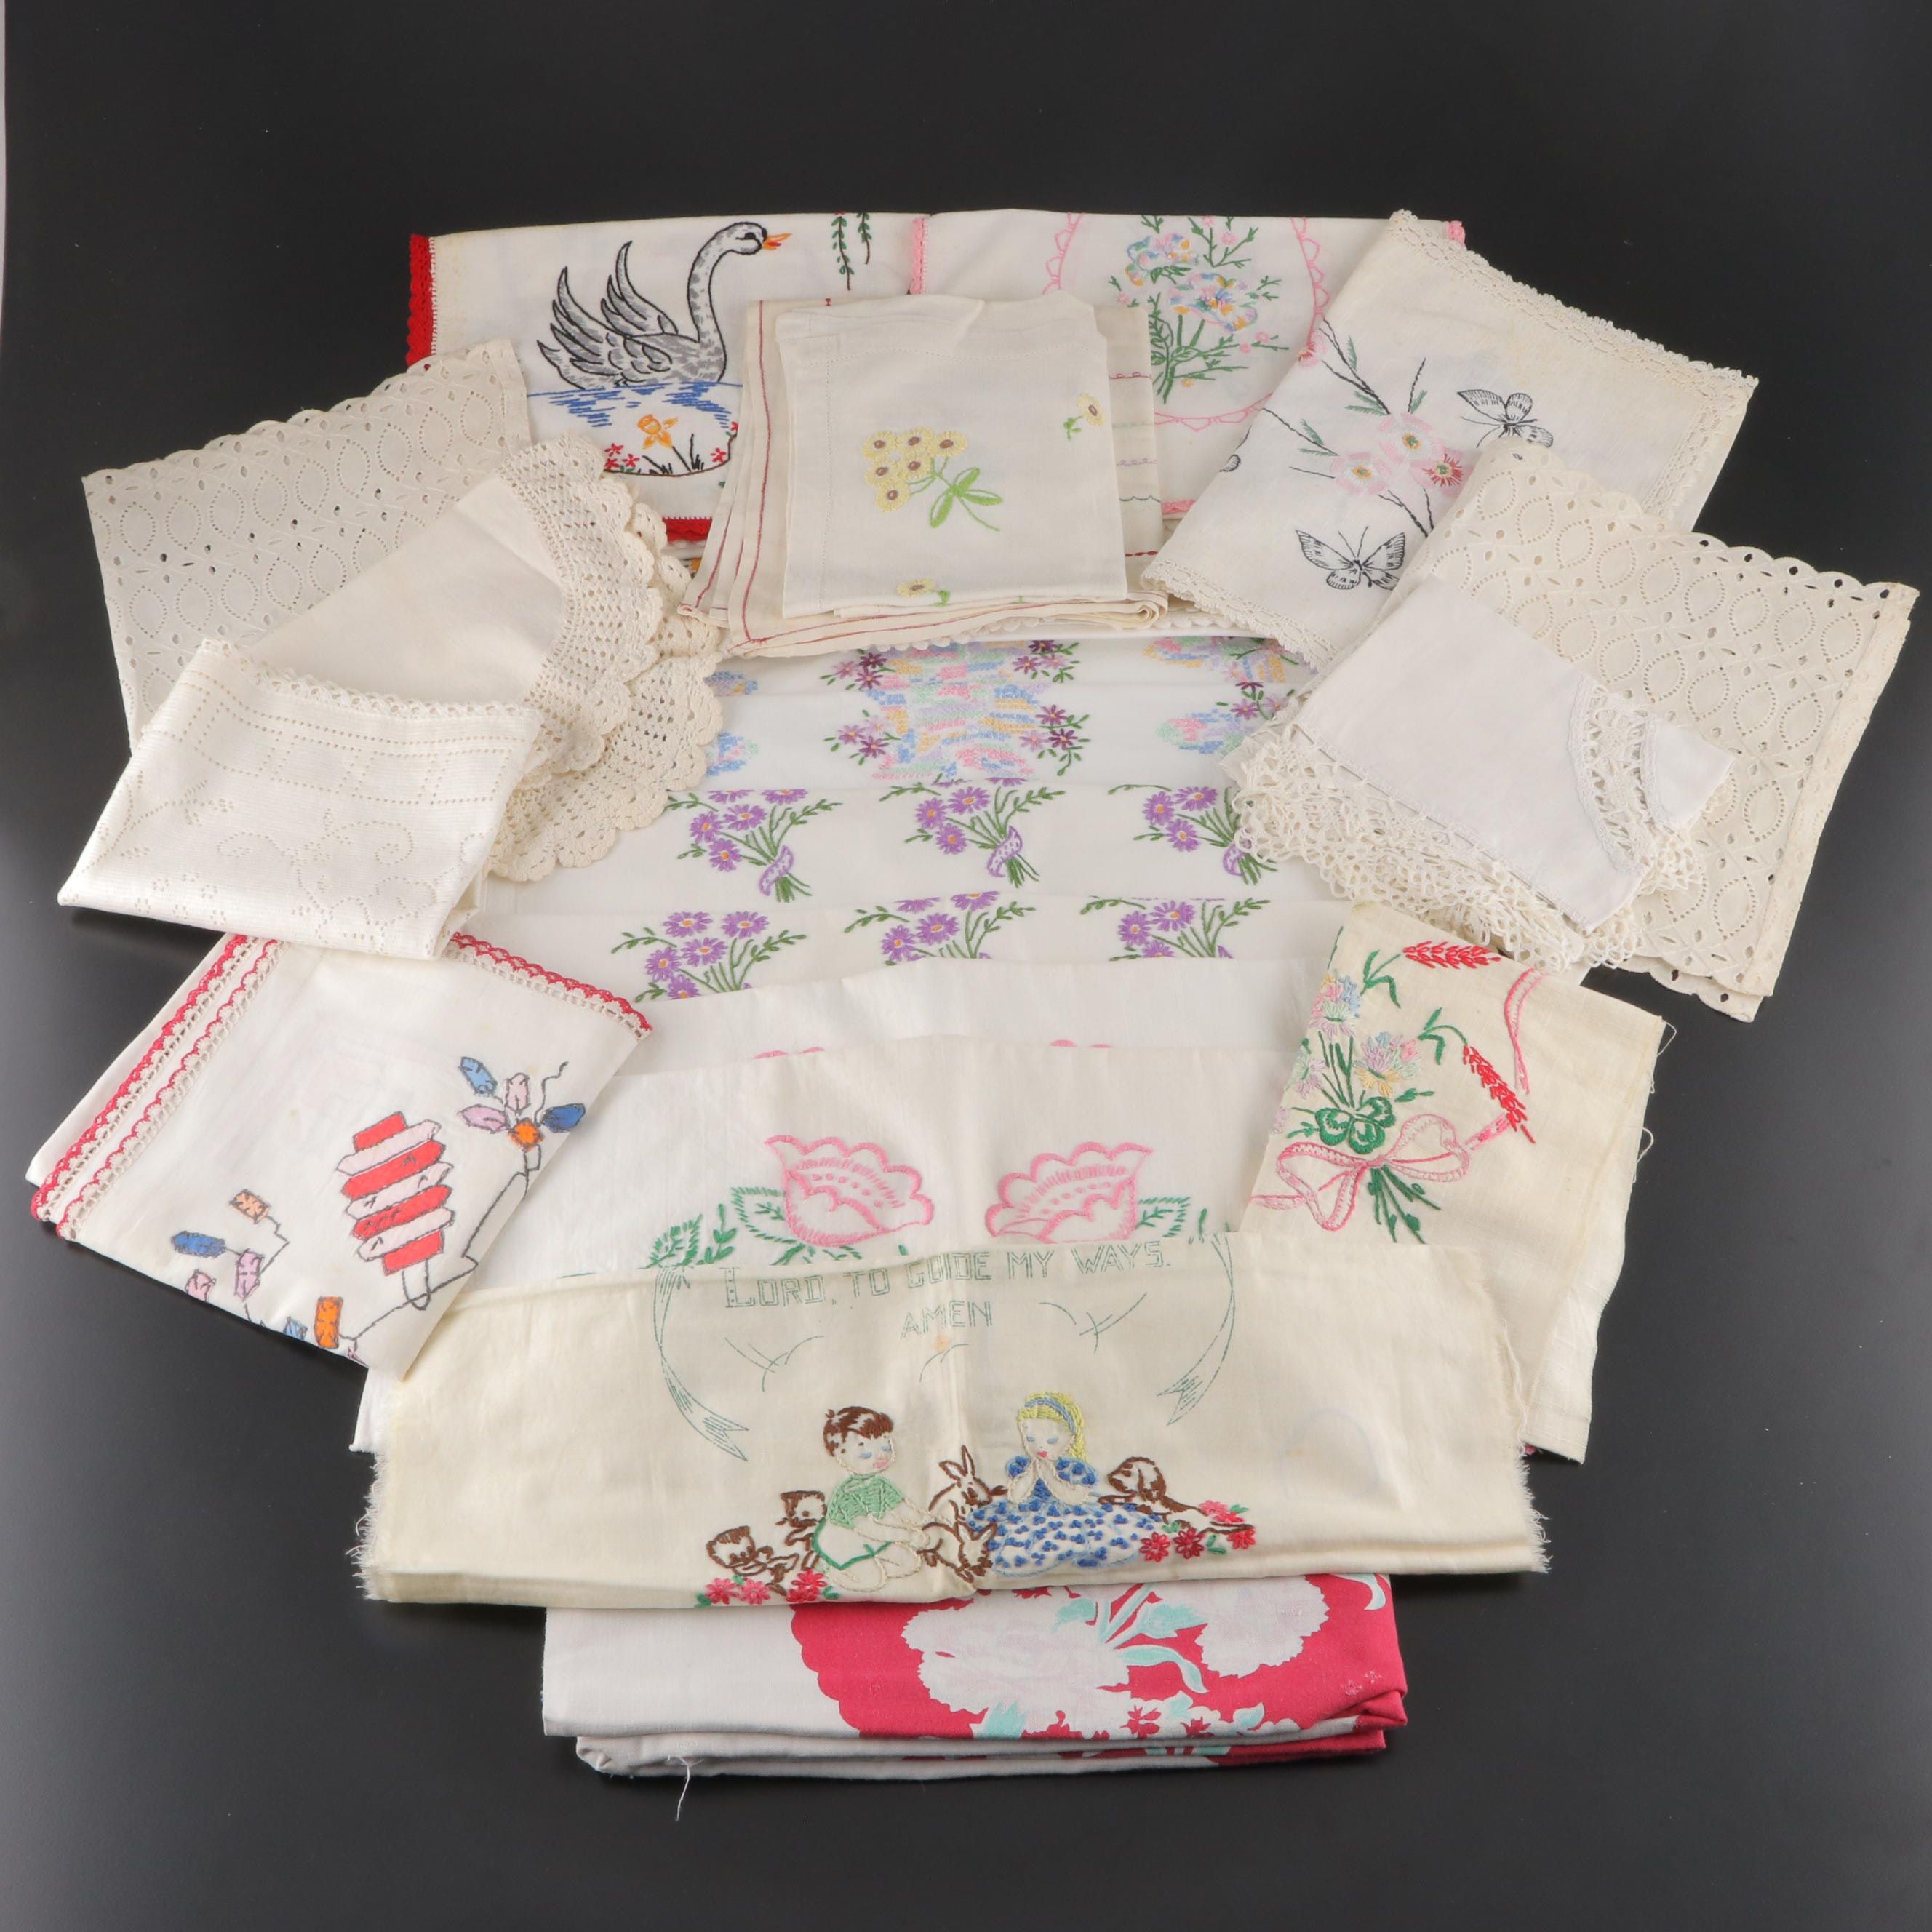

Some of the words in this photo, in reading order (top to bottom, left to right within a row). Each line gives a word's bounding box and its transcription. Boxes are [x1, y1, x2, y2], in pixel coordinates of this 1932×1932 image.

[843, 1268, 890, 1297] TO
[906, 1251, 991, 1288] GUIDE
[1007, 1250, 1054, 1279] MY
[900, 1300, 992, 1340] AMEN
